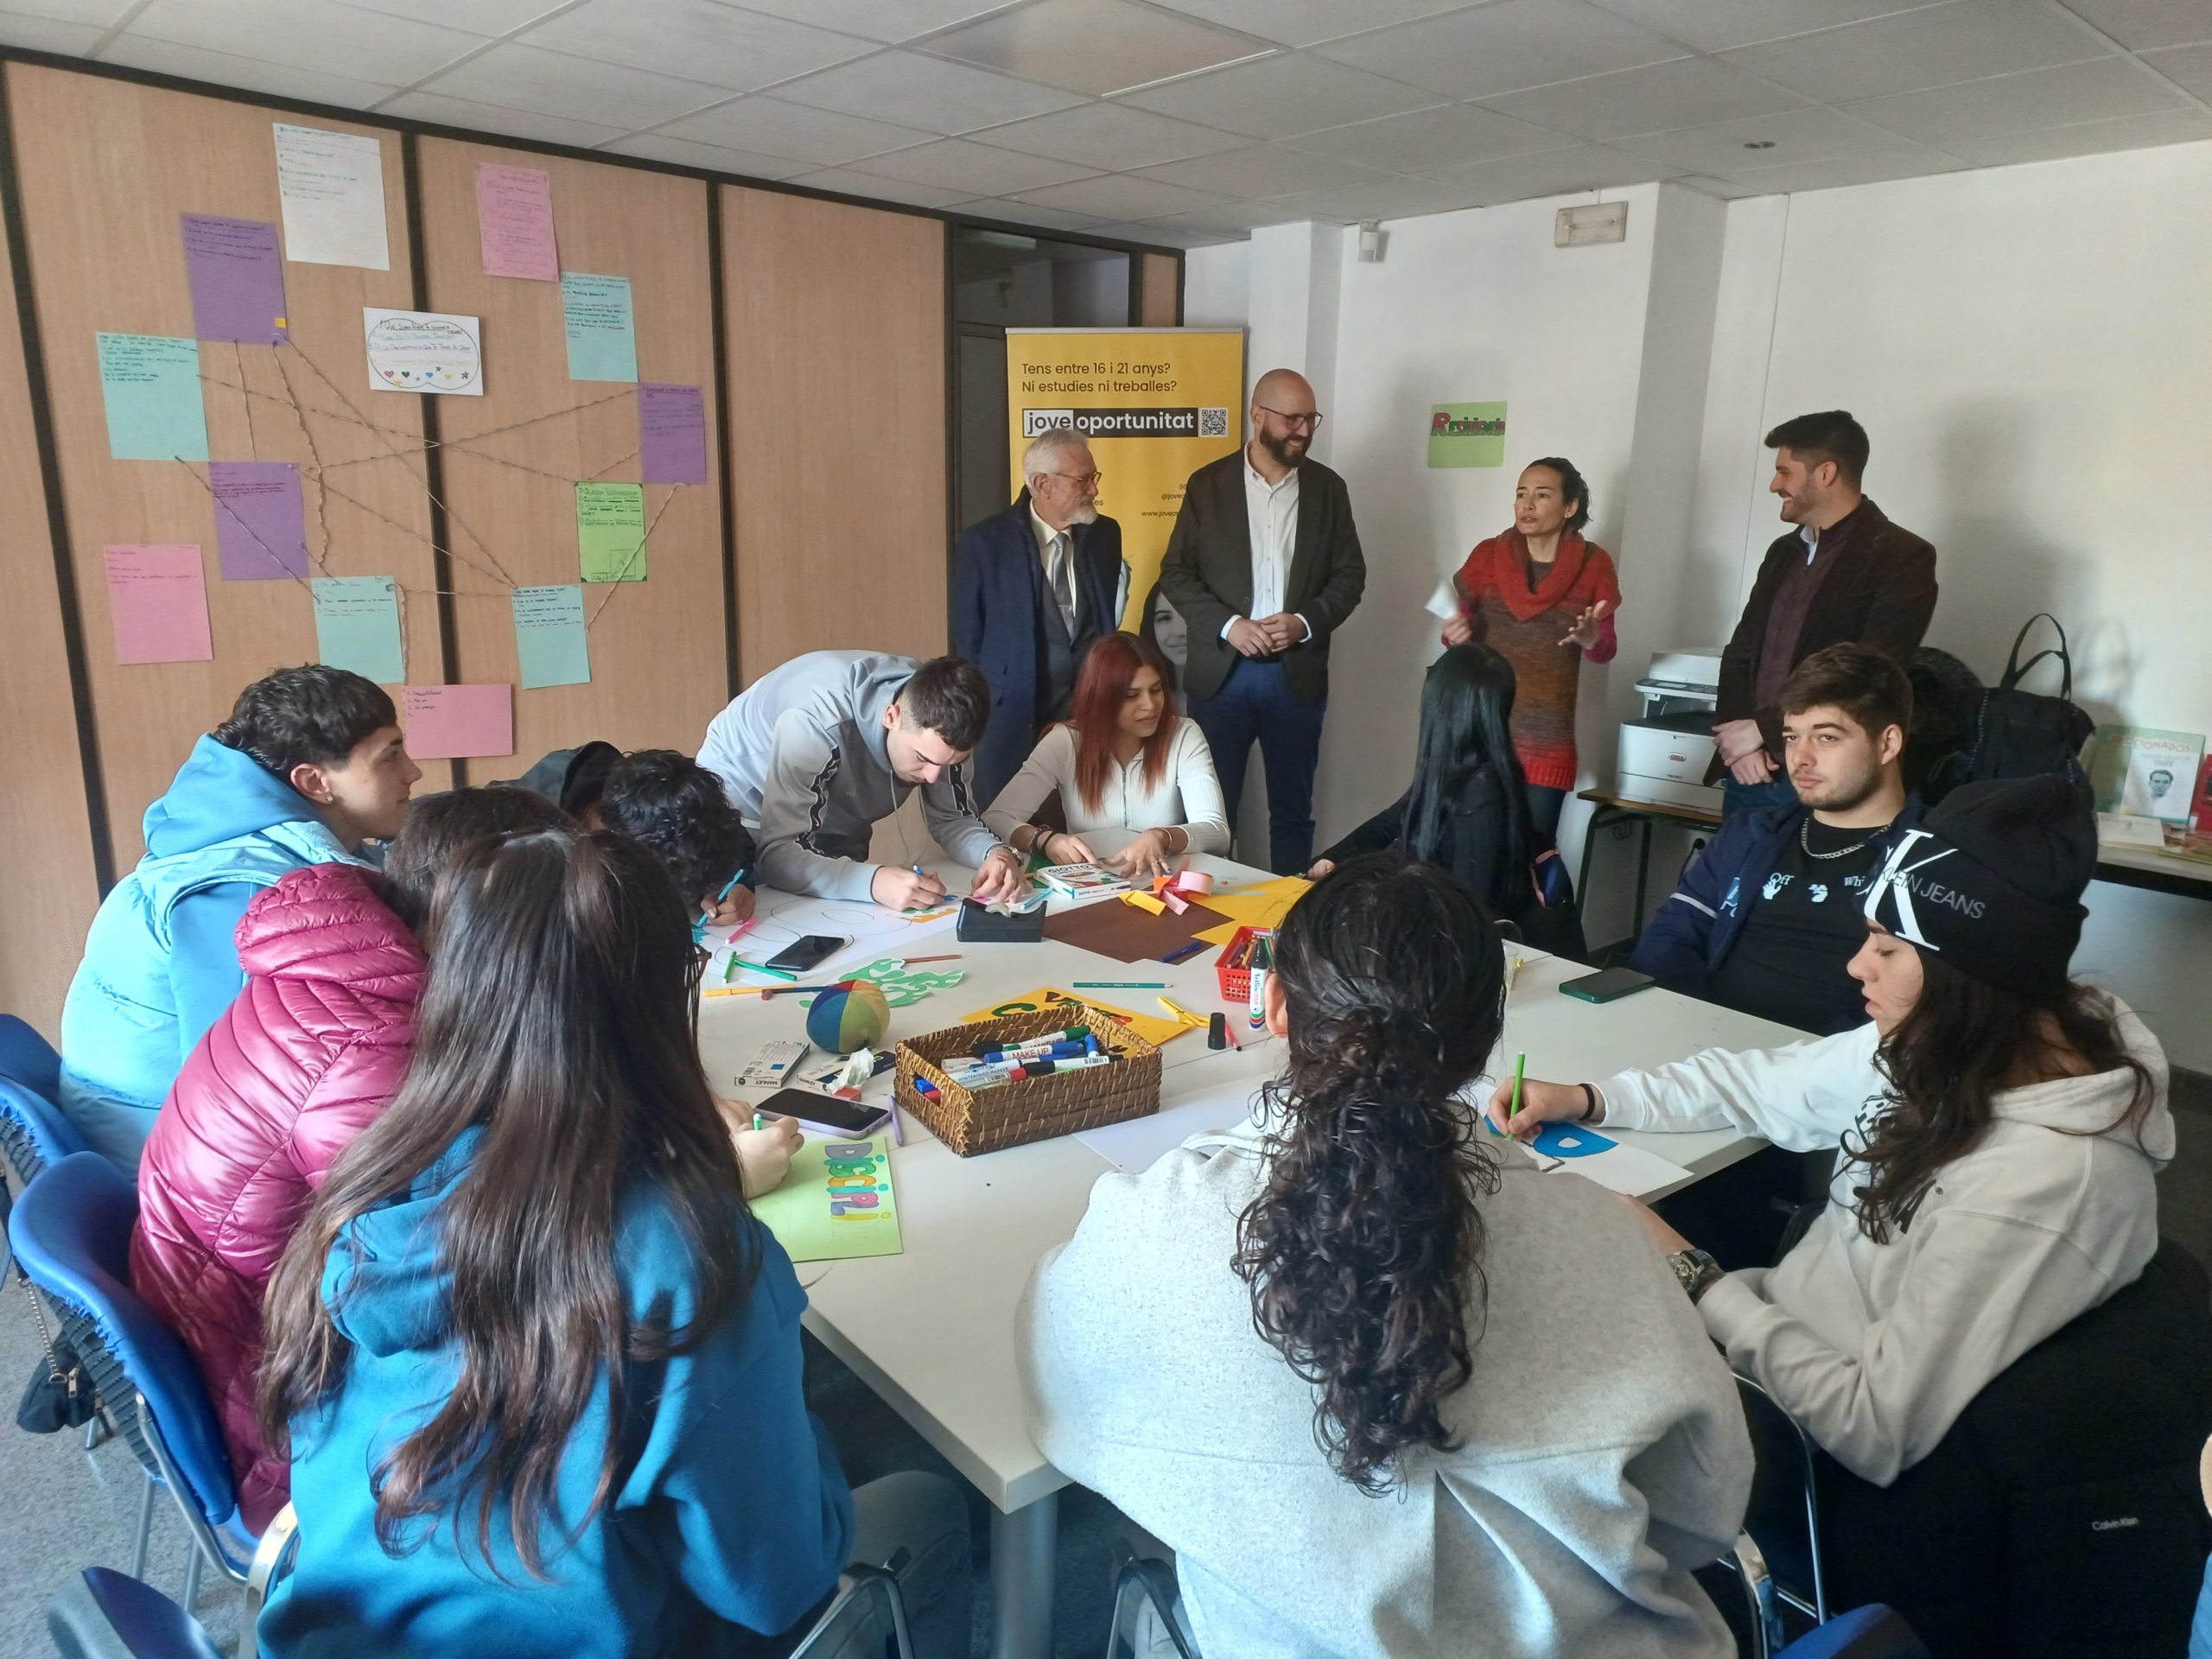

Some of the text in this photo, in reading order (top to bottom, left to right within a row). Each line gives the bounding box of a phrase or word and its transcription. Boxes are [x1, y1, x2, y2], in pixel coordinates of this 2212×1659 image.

[1021, 362, 1171, 378] Tens entre 16 i 21 anys?
[1022, 380, 1177, 392] Ni estudies ni treballes?
[1027, 411, 1194, 435] jove oportunitat
[1920, 882, 1986, 918] JEANS
[1012, 1047, 1049, 1059] MAKE UP
